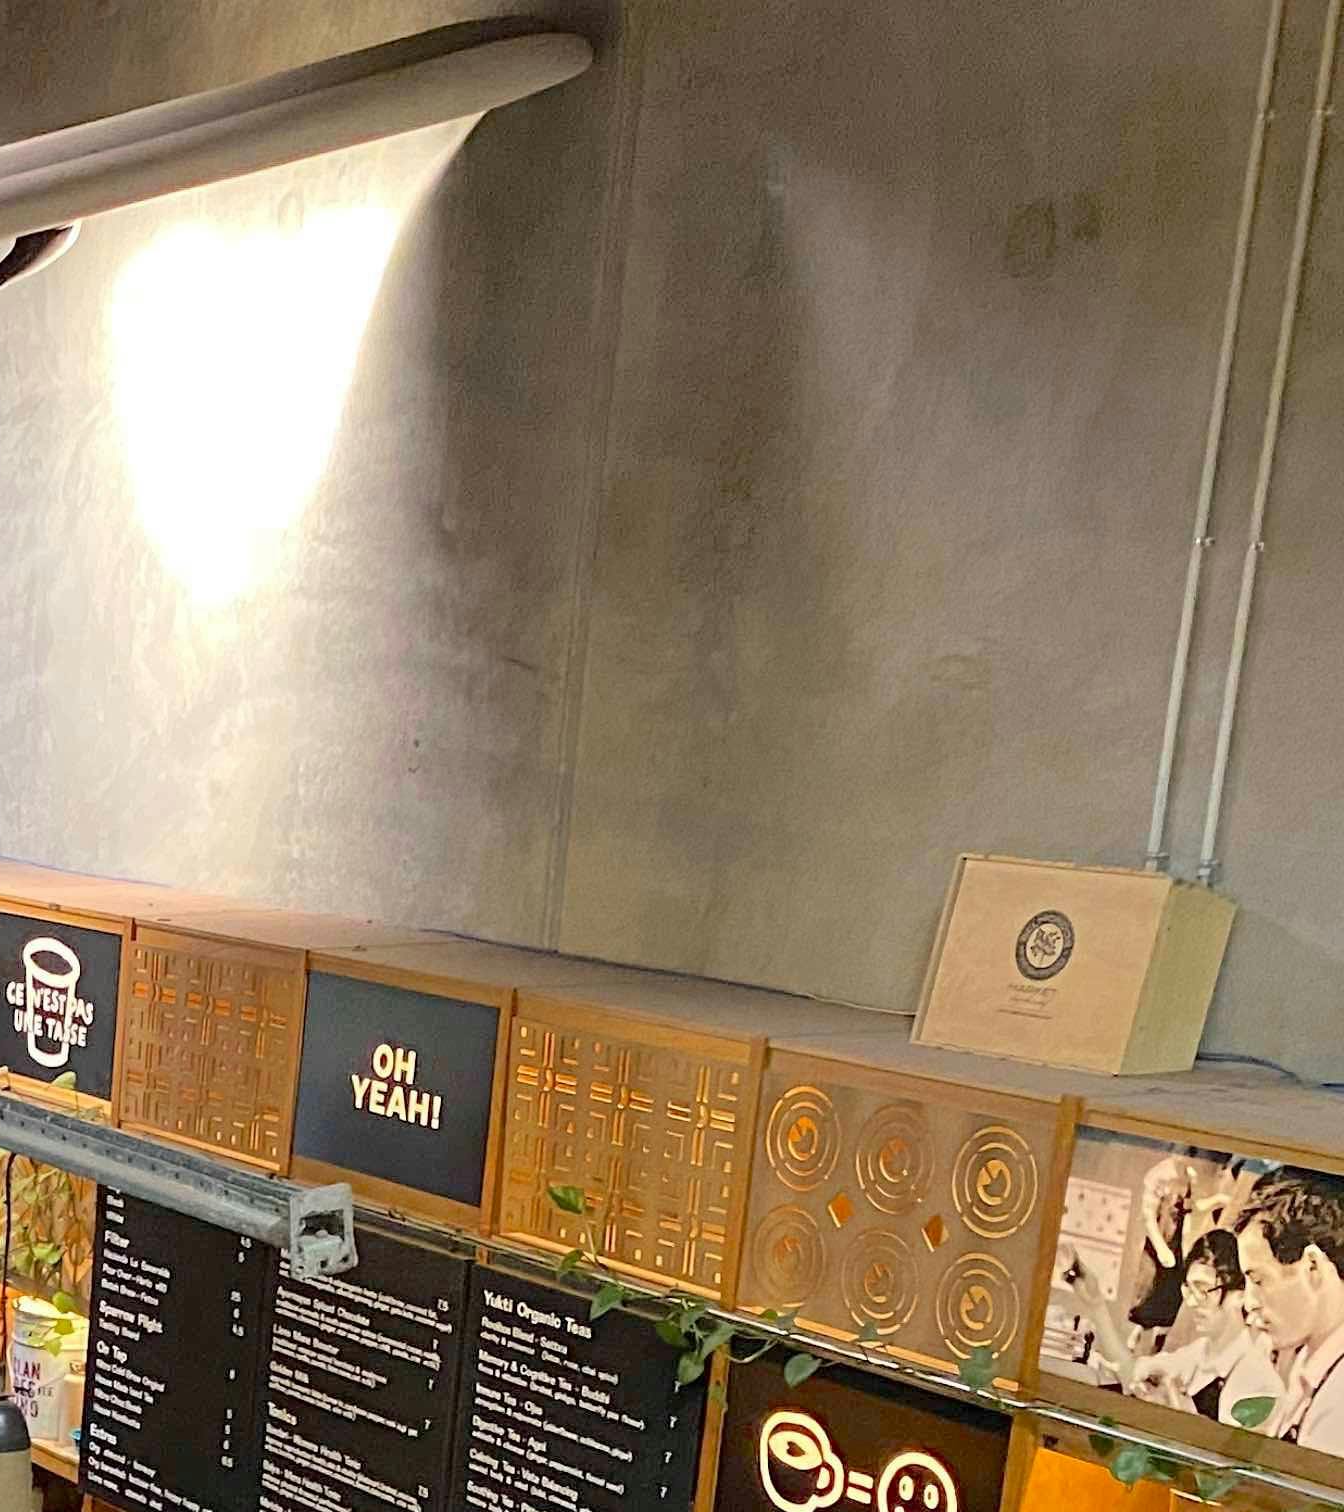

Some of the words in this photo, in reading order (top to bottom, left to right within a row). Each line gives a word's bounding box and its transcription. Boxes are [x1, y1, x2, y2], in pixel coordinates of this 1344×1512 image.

[6, 981, 25, 1006] CE
[71, 997, 94, 1025] PAS
[14, 1008, 43, 1037] UNE
[45, 1016, 87, 1048] TASSE
[373, 1044, 417, 1085] OH
[352, 1073, 442, 1130] YEAH!
[105, 1230, 129, 1248] Filter
[99, 1300, 135, 1323] Sparrow
[138, 1313, 163, 1333] Flight
[484, 1290, 513, 1312] Yukti
[517, 1302, 561, 1328] Organic
[565, 1317, 591, 1338] Teas
[90, 1423, 117, 1445] Extras
